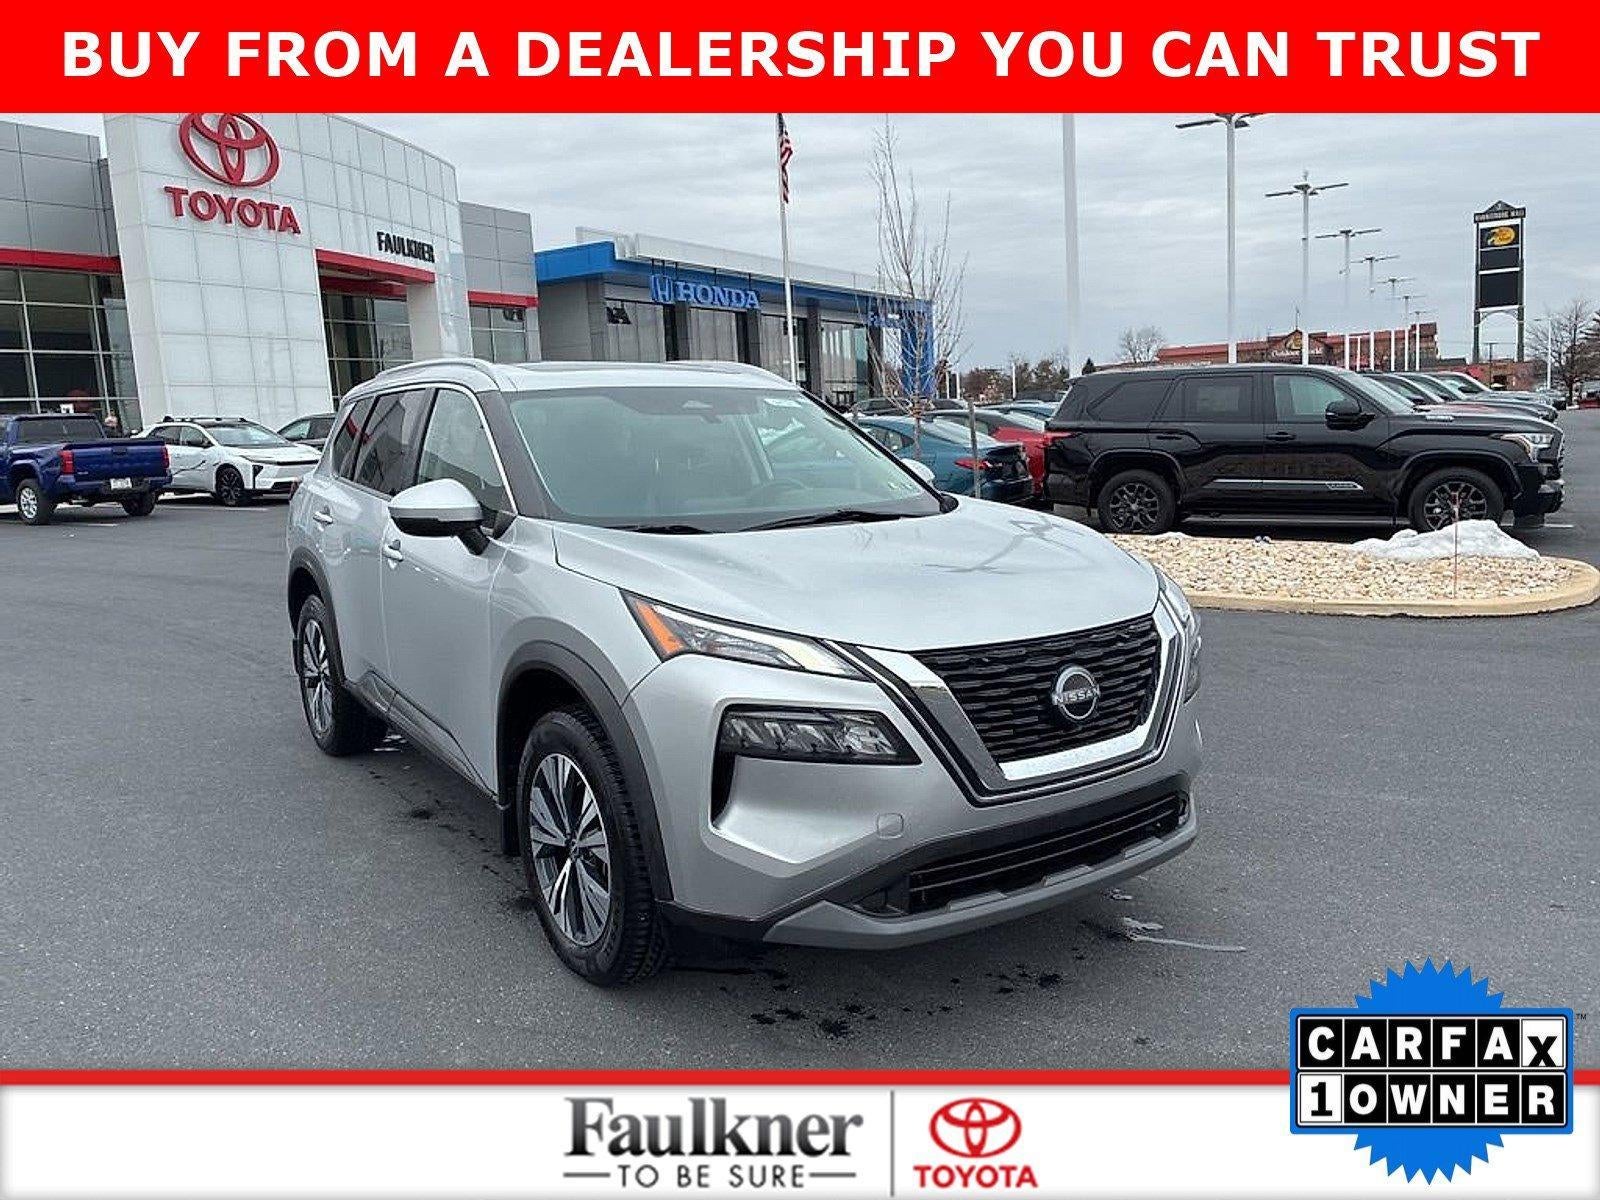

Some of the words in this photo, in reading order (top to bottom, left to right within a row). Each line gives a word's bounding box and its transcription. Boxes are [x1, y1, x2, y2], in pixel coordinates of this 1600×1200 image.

[164, 185, 301, 234] TOYOTA
[376, 231, 435, 263] FAULKNER
[675, 281, 760, 308] HONDA
[1052, 684, 1101, 705] NISSAN
